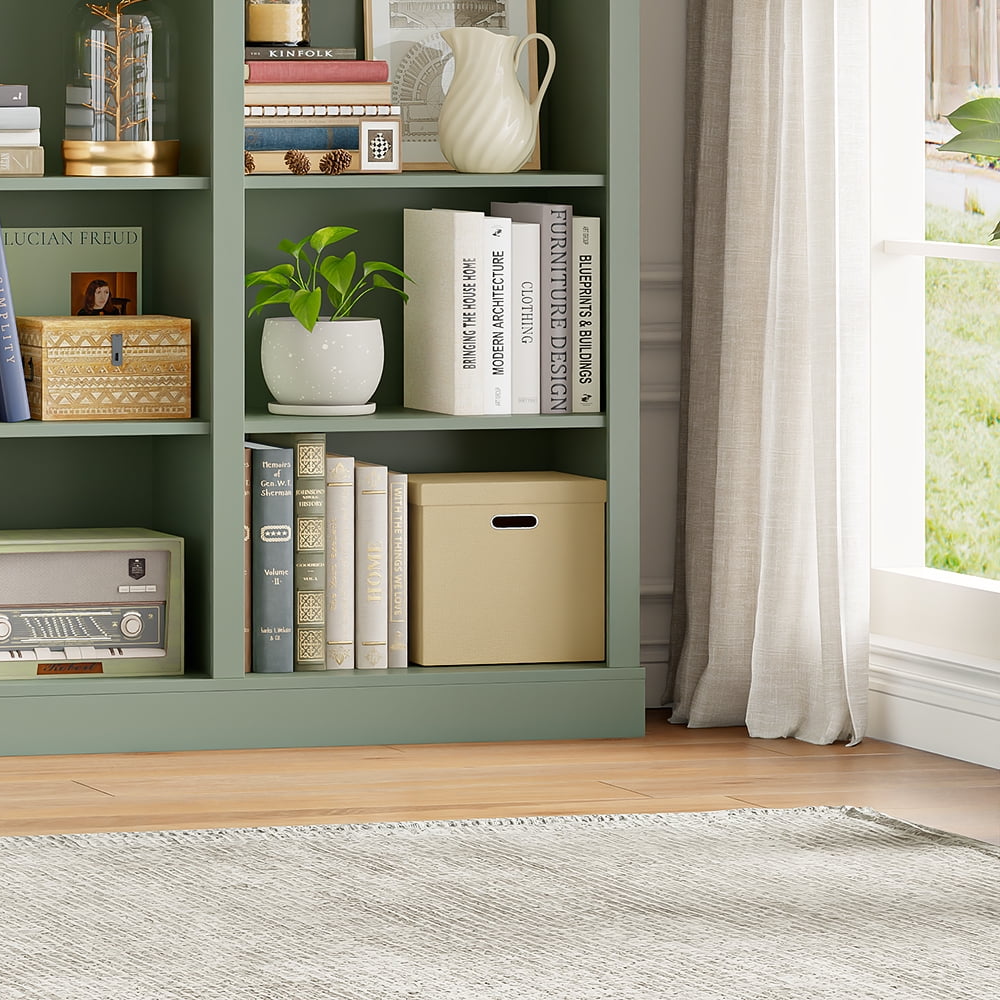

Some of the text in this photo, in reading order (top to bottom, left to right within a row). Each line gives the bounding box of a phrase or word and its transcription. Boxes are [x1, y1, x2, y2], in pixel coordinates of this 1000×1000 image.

[268, 49, 333, 58] KINFOLK
[4, 231, 139, 246] LUCIAN FREUD
[492, 250, 504, 329] ARCHITECTURE
[550, 209, 568, 411] FURNITURE DESIGN
[579, 255, 593, 317] BLUEPRINTS
[463, 258, 476, 369] BRINGING THE HOUSE HOME
[521, 281, 534, 344] CLOTHING
[579, 318, 593, 327] &
[492, 331, 504, 375] MODERN
[579, 330, 593, 385] BUILDINGS
[262, 461, 291, 469] Memoirs
[273, 469, 281, 478] of
[261, 489, 292, 497] Sherman
[264, 567, 289, 576] Volume
[368, 544, 382, 602] HOME
[394, 487, 403, 616] WITH THE THINGS WE LOVE
